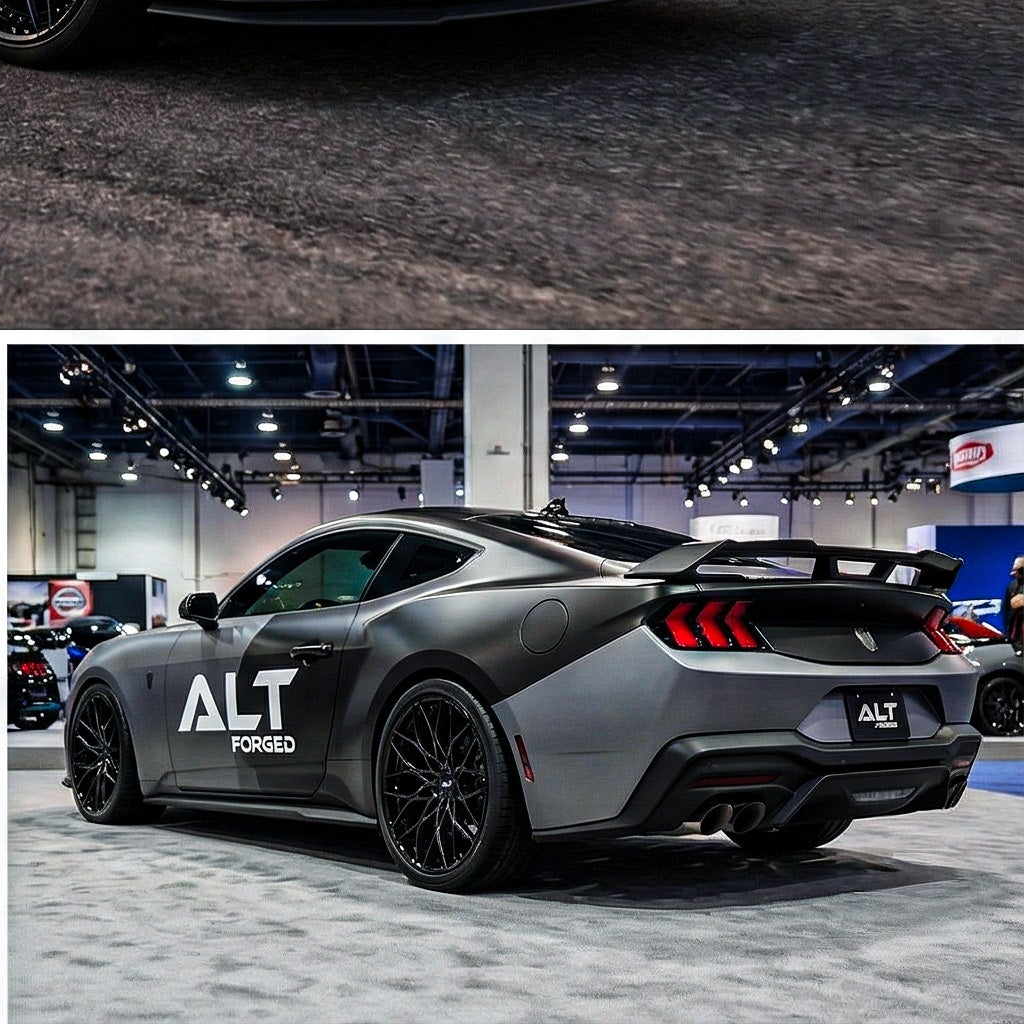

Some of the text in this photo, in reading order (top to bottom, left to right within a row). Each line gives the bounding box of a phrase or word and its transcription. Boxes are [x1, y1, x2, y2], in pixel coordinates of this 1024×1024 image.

[178, 668, 299, 732] ALT
[858, 702, 897, 721] ALT
[231, 735, 296, 753] FORGED
